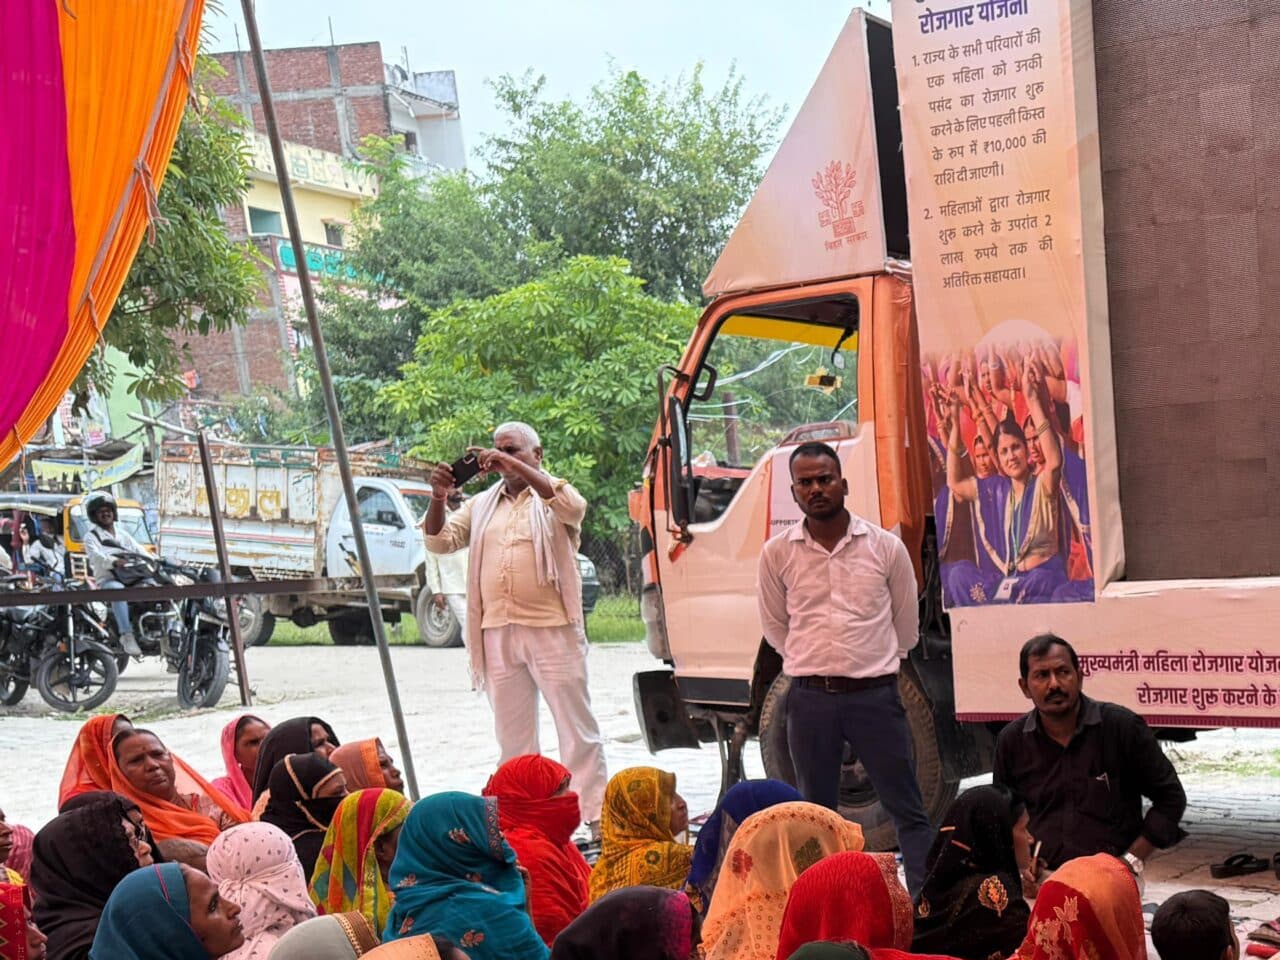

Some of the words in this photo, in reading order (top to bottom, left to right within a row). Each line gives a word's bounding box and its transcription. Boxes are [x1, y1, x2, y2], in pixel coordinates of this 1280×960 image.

[918, 5, 974, 34] रोजगार
[912, 55, 920, 67] 1.
[923, 49, 945, 65] राज्य
[948, 44, 959, 60] के
[962, 39, 982, 57] सभी
[986, 31, 1023, 53] परिवारों
[1026, 27, 1040, 44] की
[927, 74, 944, 88] एक
[952, 67, 984, 84] महिला
[992, 60, 1007, 77] को
[1014, 53, 1042, 73] उनकी
[928, 97, 952, 113] पसंद
[960, 94, 975, 108] का
[982, 86, 1017, 104] रोजगार
[930, 119, 952, 137] करने
[954, 118, 965, 133] के
[966, 115, 987, 132] लिए
[988, 107, 1016, 128] पहली
[1018, 106, 1045, 122] किस्त
[932, 147, 943, 161] के
[969, 140, 978, 155] में
[983, 135, 1027, 153] ₹10,000
[1032, 128, 1047, 144] की
[934, 168, 955, 185] राशि
[956, 166, 968, 182] दी
[968, 161, 1004, 180] जाएगी।
[923, 208, 933, 220] 2.
[939, 196, 983, 217] महिलाओं
[989, 195, 1009, 213] द्वारा
[1016, 189, 1050, 206] रोजगार
[846, 231, 869, 244] सरकार
[962, 221, 984, 238] करने
[991, 218, 1002, 233] के
[1008, 214, 1038, 232] उपरांत
[1045, 214, 1052, 227] 2
[940, 251, 964, 265] लाख
[1009, 242, 1028, 256] तक
[1039, 235, 1053, 251] की
[943, 271, 982, 289] अतिरिक्त
[983, 266, 1026, 284] सहायता।
[1078, 650, 1139, 676] मुख्यमंत्री
[1142, 650, 1188, 672] महिला
[1191, 650, 1244, 673] रोजगार
[1136, 682, 1188, 704] रोजगार
[1221, 684, 1259, 706] करने
[1262, 684, 1277, 706] के
